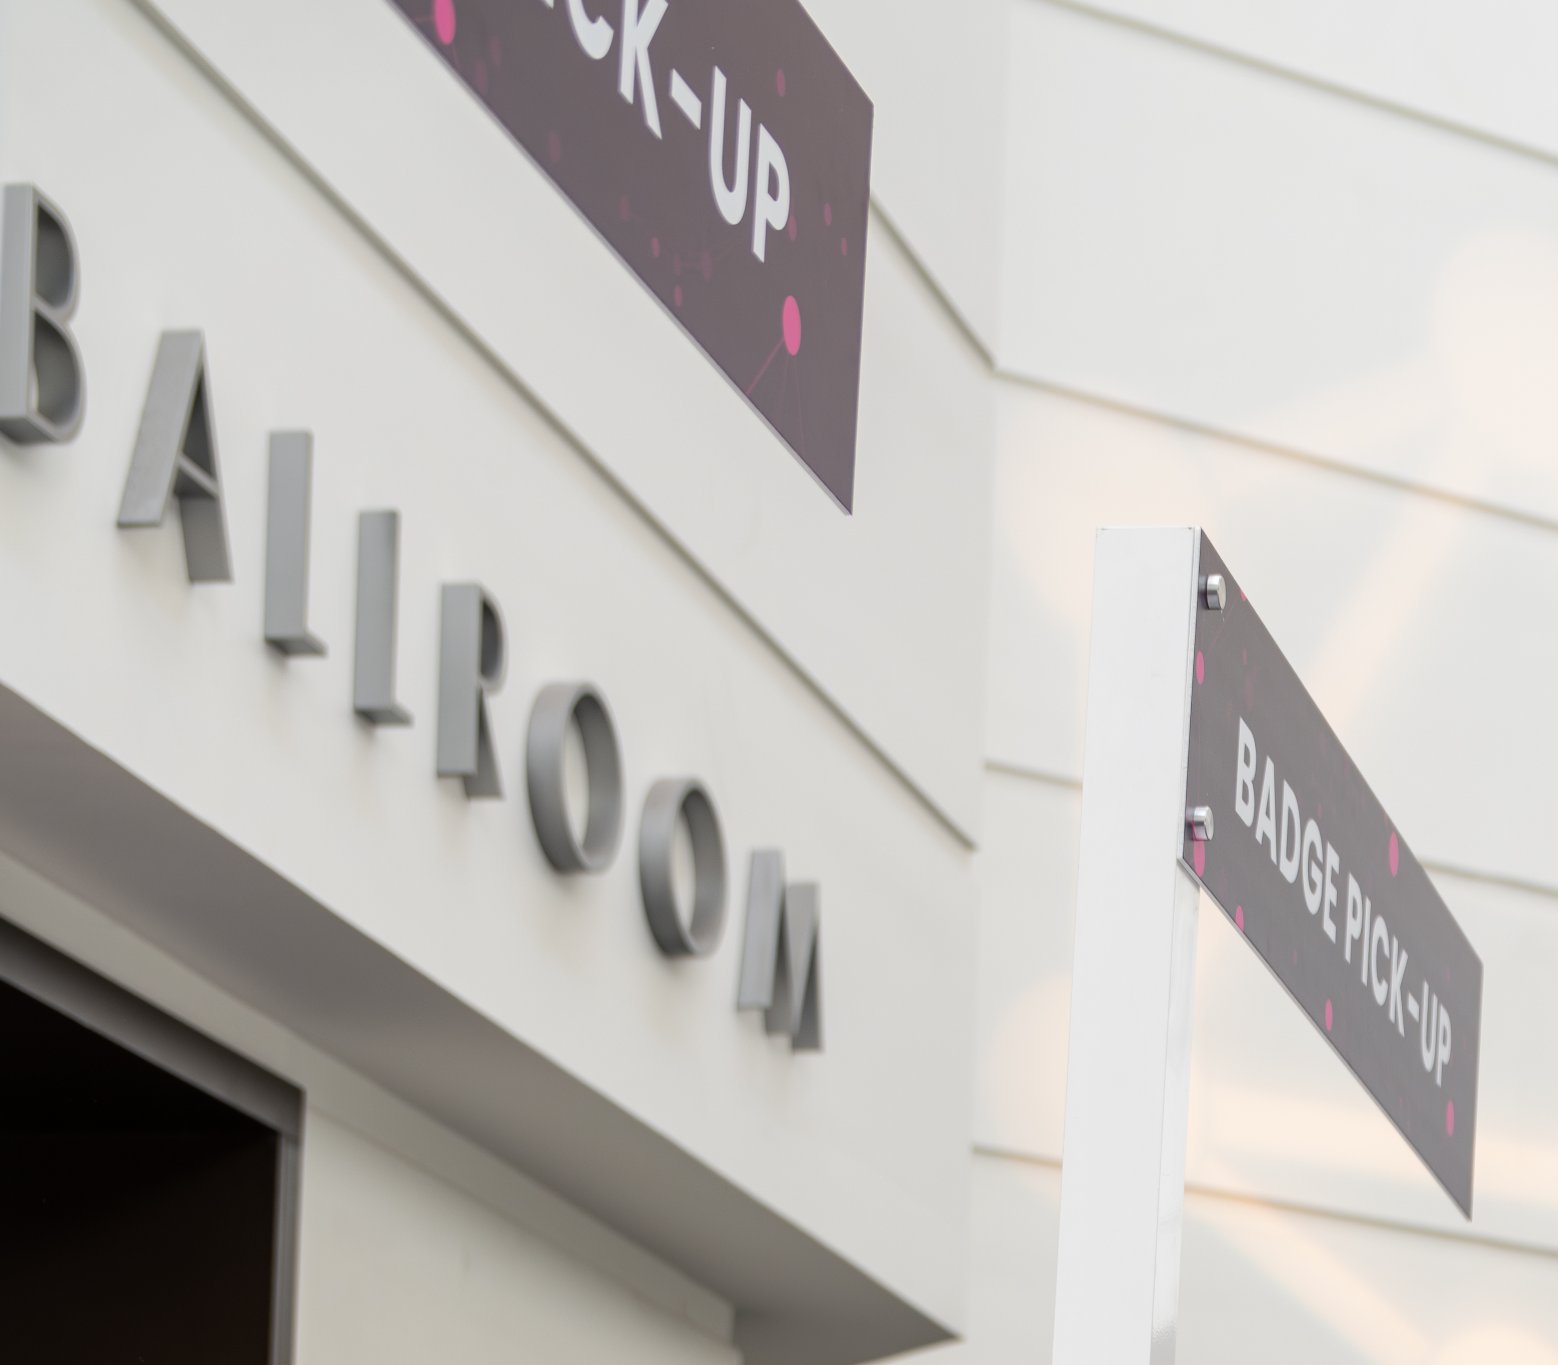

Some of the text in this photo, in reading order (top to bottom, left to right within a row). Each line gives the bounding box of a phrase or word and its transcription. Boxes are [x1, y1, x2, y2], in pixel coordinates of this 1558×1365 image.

[541, 0, 790, 263] K-UP
[1, 183, 822, 1051] BALLROOM
[1234, 716, 1452, 1087] BADGE PICK-UP
